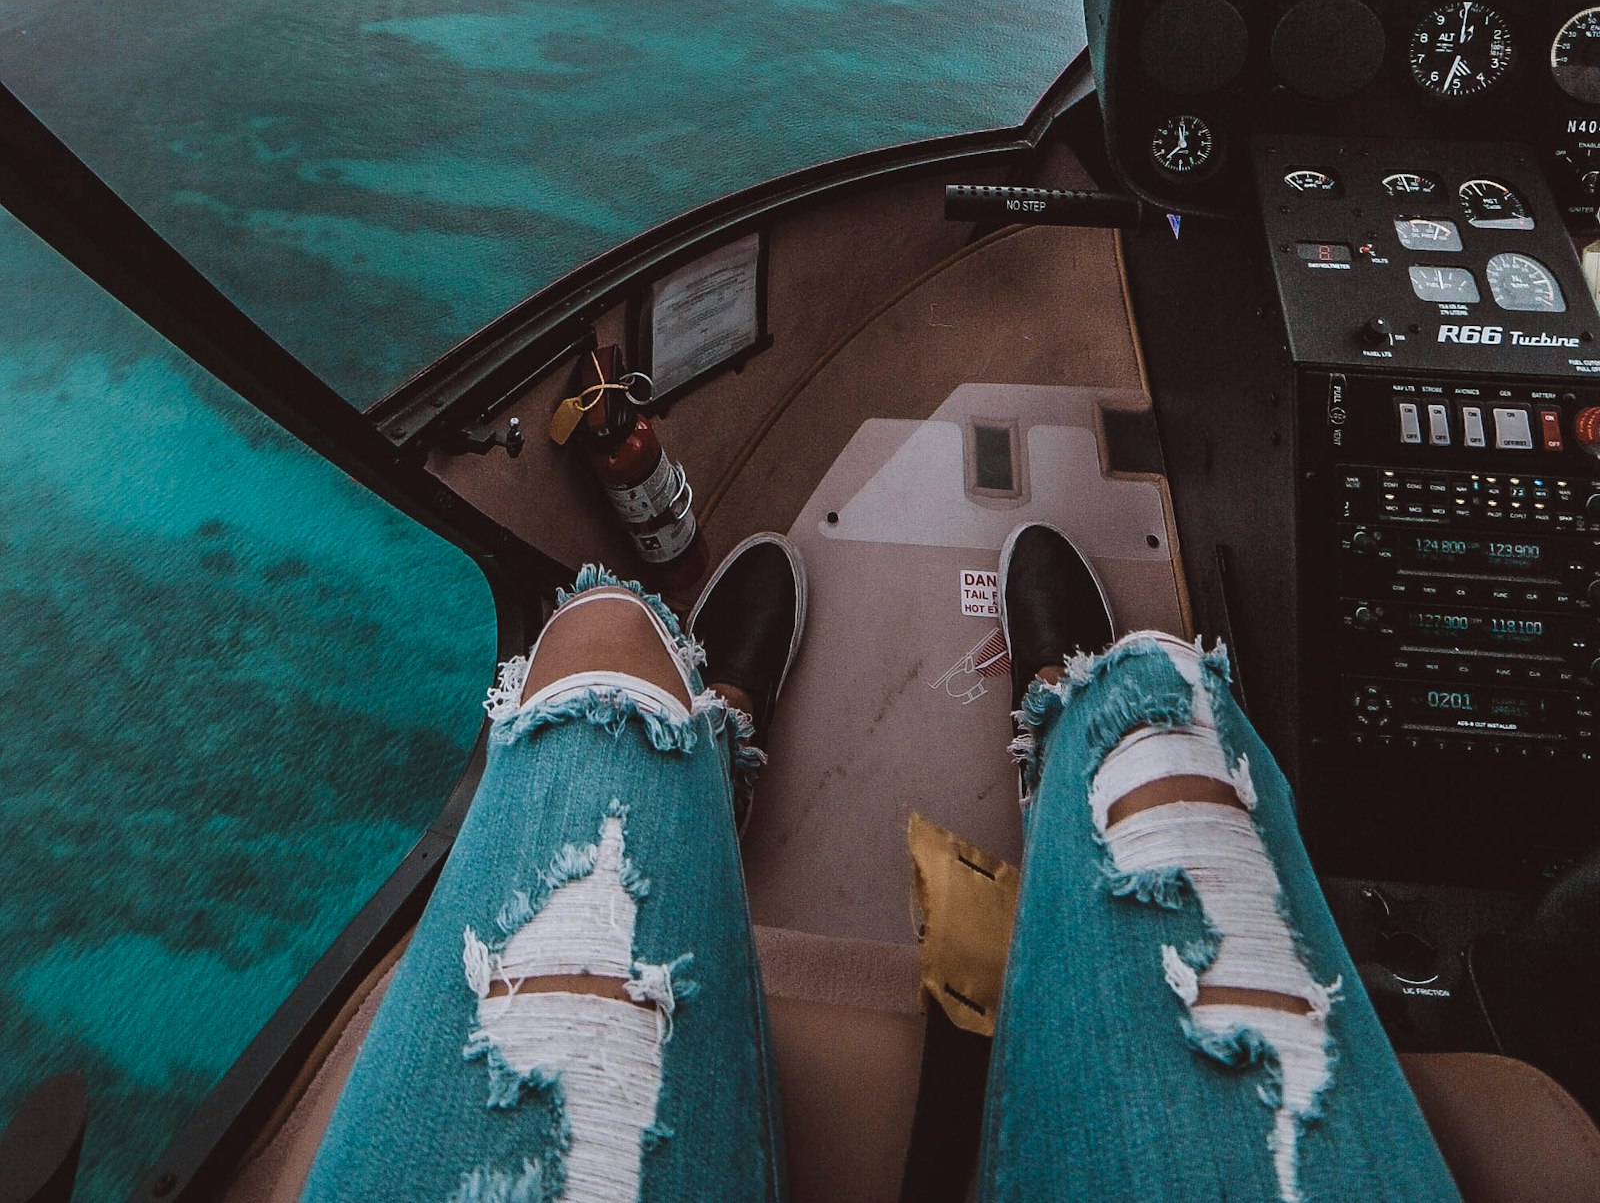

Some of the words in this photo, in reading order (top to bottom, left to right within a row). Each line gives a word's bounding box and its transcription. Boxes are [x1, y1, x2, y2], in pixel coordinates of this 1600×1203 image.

[1436, 15, 1446, 26] 9
[1419, 32, 1429, 43] 8
[1438, 32, 1456, 41] ALT
[1493, 29, 1502, 40] 2
[1417, 53, 1426, 64] 7
[1490, 58, 1500, 69] 3
[1430, 71, 1440, 82] 6
[1452, 78, 1461, 89] 5
[1567, 119, 1600, 134] N40
[1006, 199, 1021, 211] NO
[1022, 200, 1047, 212] STEP
[1437, 324, 1504, 345] R66
[1509, 331, 1580, 348] Turbine
[1333, 385, 1342, 403] PULL
[1544, 414, 1556, 422] ON
[1489, 542, 1540, 559] 123.900
[964, 590, 988, 600] TAIL
[965, 604, 985, 613] HOT
[1428, 691, 1473, 710] 0201
[1415, 988, 1450, 997] FRICTION
